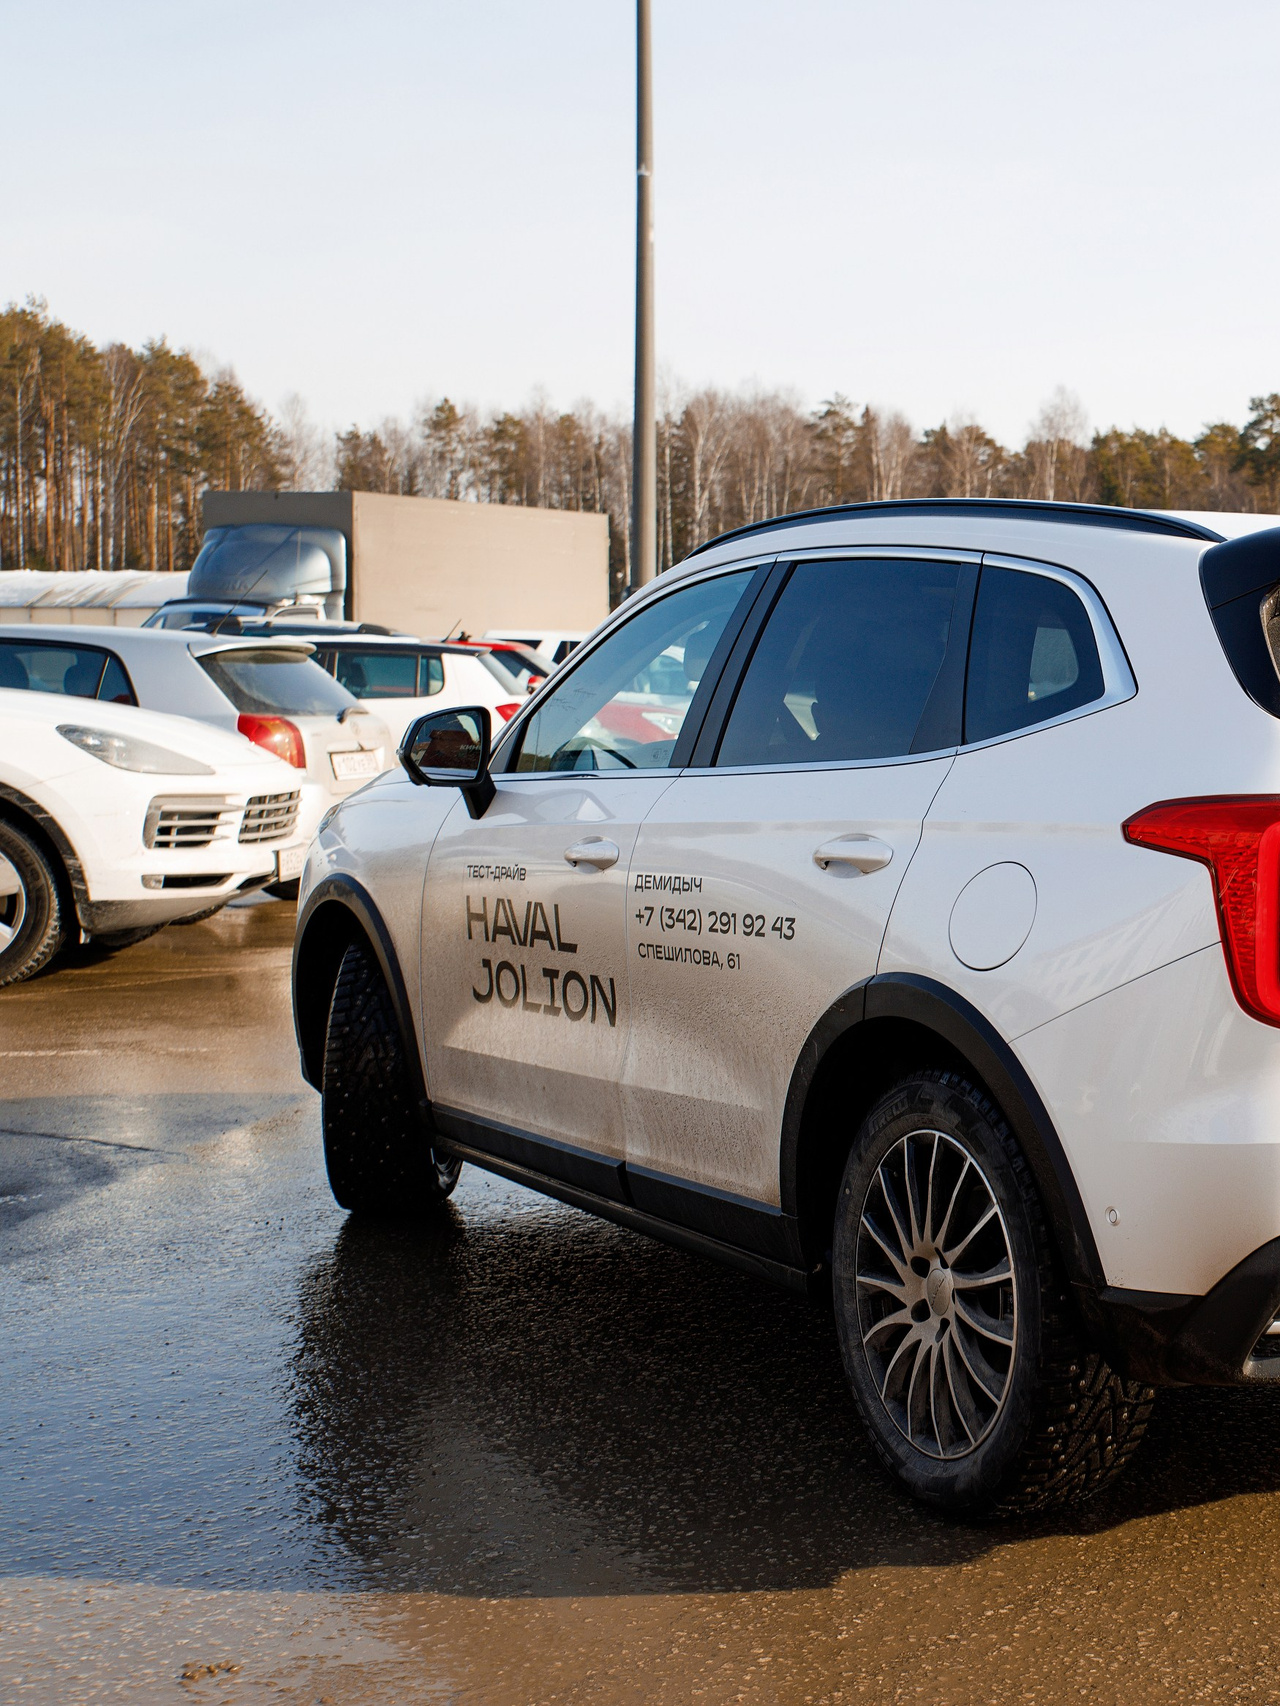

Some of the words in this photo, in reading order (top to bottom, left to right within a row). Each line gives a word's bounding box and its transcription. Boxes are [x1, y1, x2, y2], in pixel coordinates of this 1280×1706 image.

[467, 864, 527, 882] ТЕСТ-ДРАЙВ
[635, 874, 703, 895] ДЕМИДЫЧ
[466, 895, 578, 953] HAVAL
[635, 906, 655, 926] +7
[660, 906, 703, 935] (342)
[708, 911, 737, 935] 291
[742, 914, 766, 937] 92
[771, 916, 796, 940] 43
[638, 942, 724, 970] СПЕШИЛОВА,
[727, 953, 741, 969] 61
[472, 958, 617, 1027] JOLION
